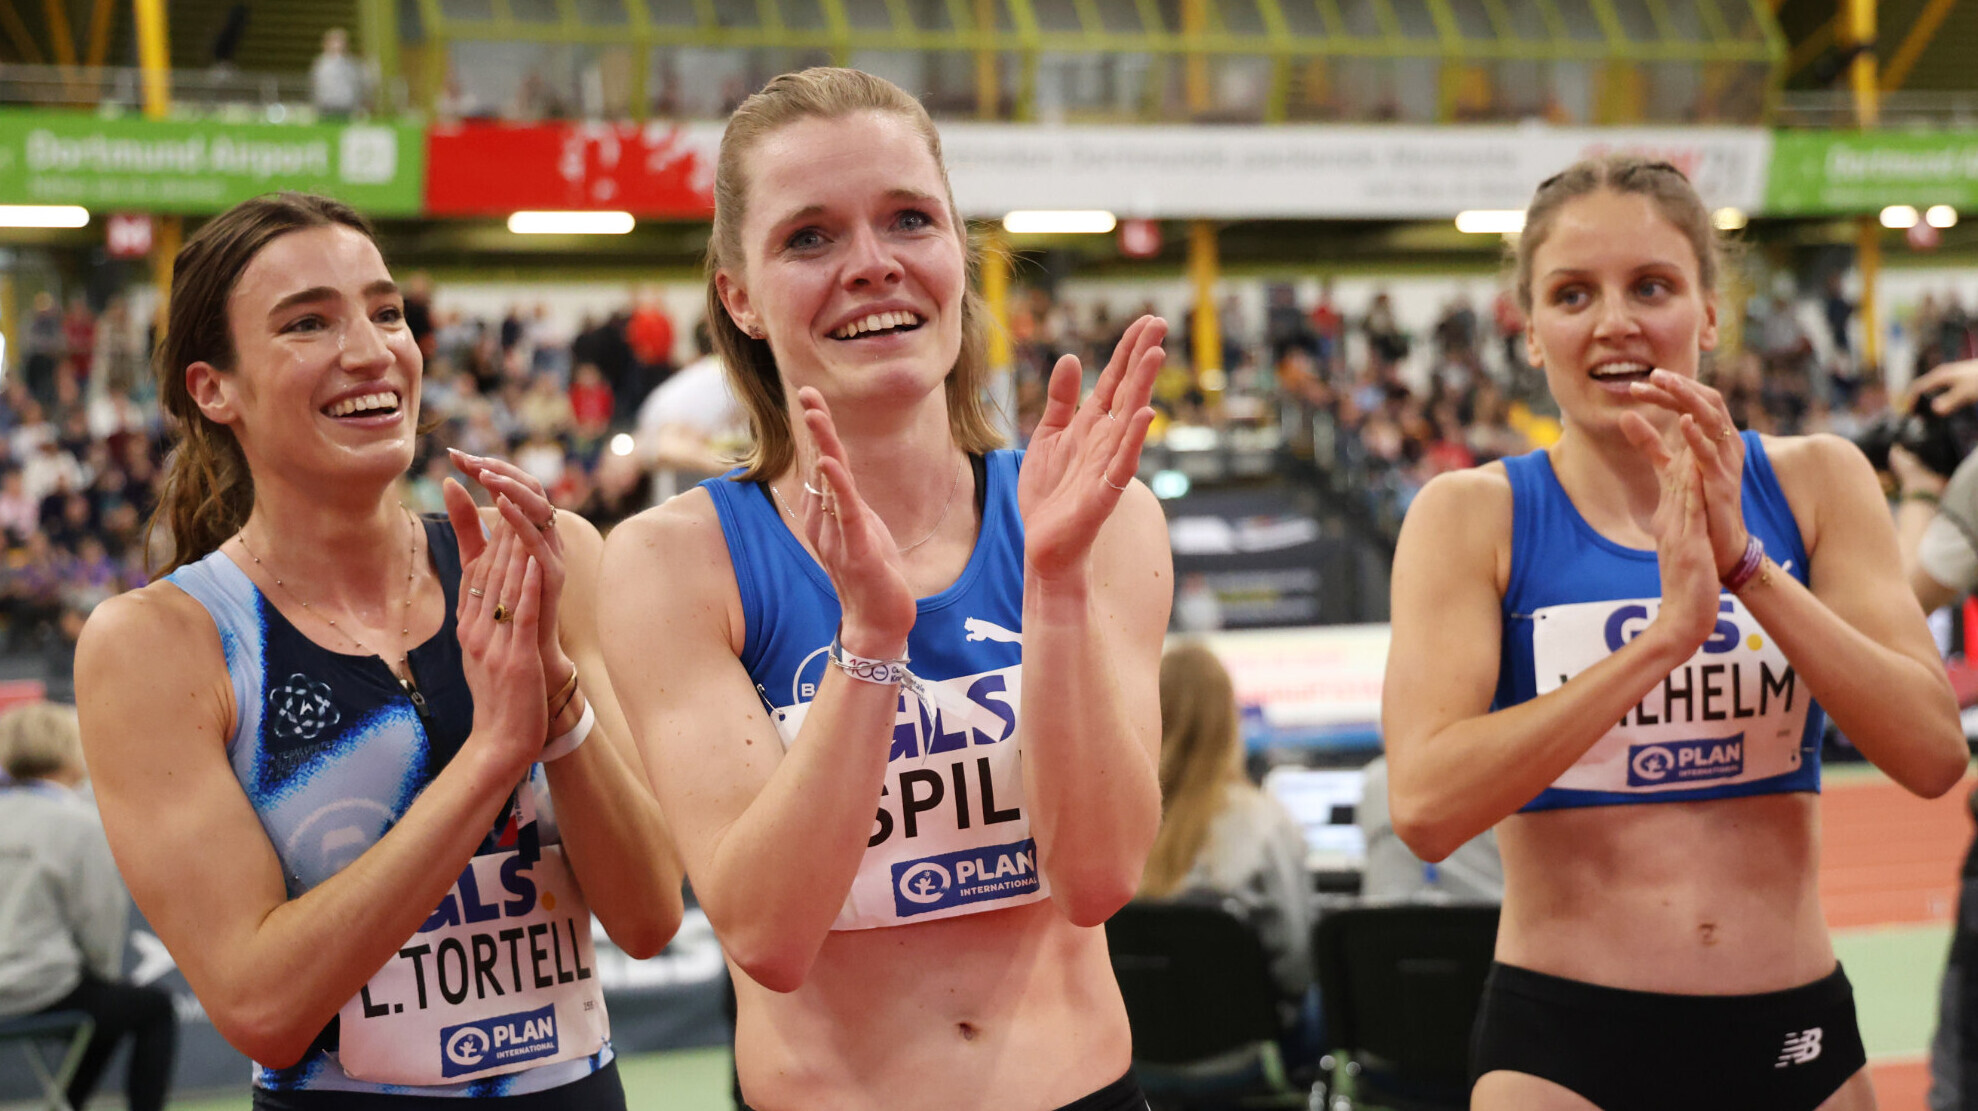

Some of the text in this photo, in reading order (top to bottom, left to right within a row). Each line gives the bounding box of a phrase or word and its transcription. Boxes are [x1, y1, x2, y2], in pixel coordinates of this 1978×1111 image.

[1678, 743, 1741, 767] PLAN
[956, 850, 1035, 885] PLAN
[960, 877, 1038, 897] INTERNATIONAL
[493, 1016, 554, 1048] PLAN
[496, 1041, 555, 1059] INTERNATIONAL
